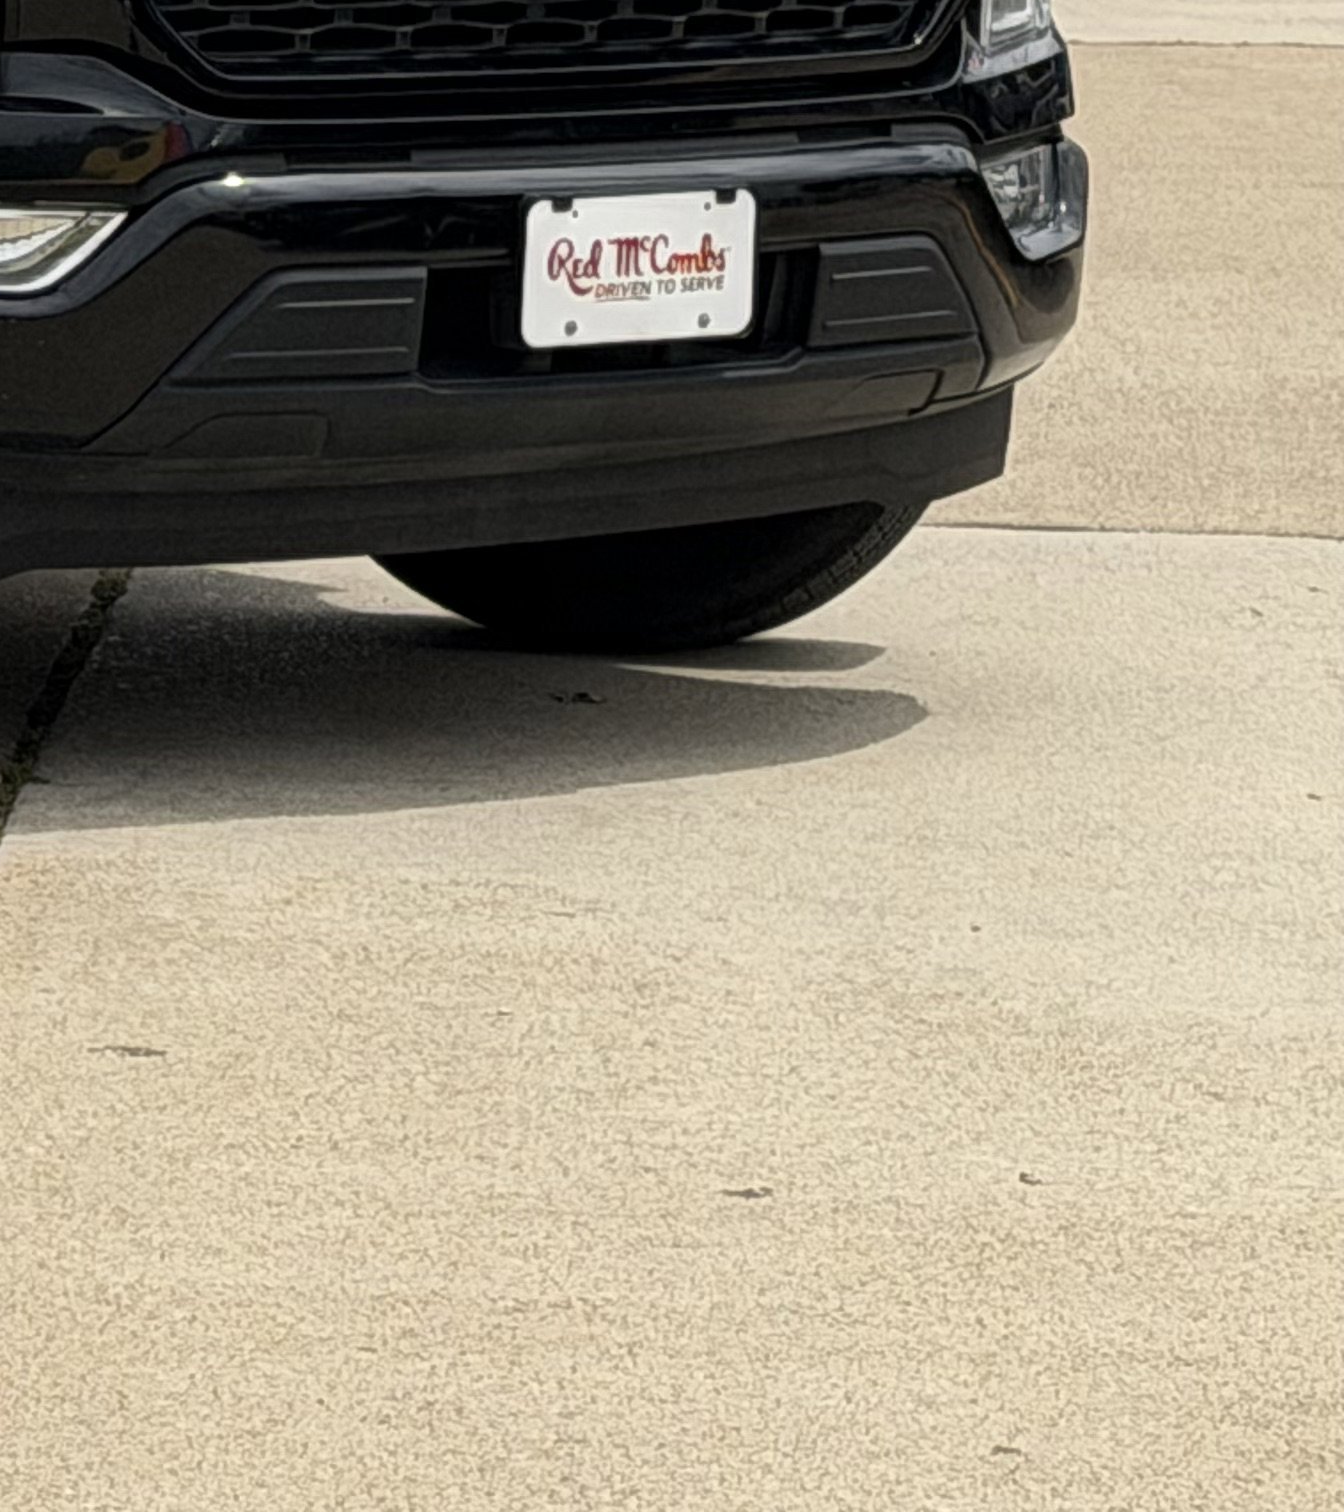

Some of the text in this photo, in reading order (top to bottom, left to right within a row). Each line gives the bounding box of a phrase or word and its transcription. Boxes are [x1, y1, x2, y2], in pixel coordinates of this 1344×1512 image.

[547, 233, 727, 296] Red McCombs
[595, 274, 725, 299] DRIVEN TO SERVE
